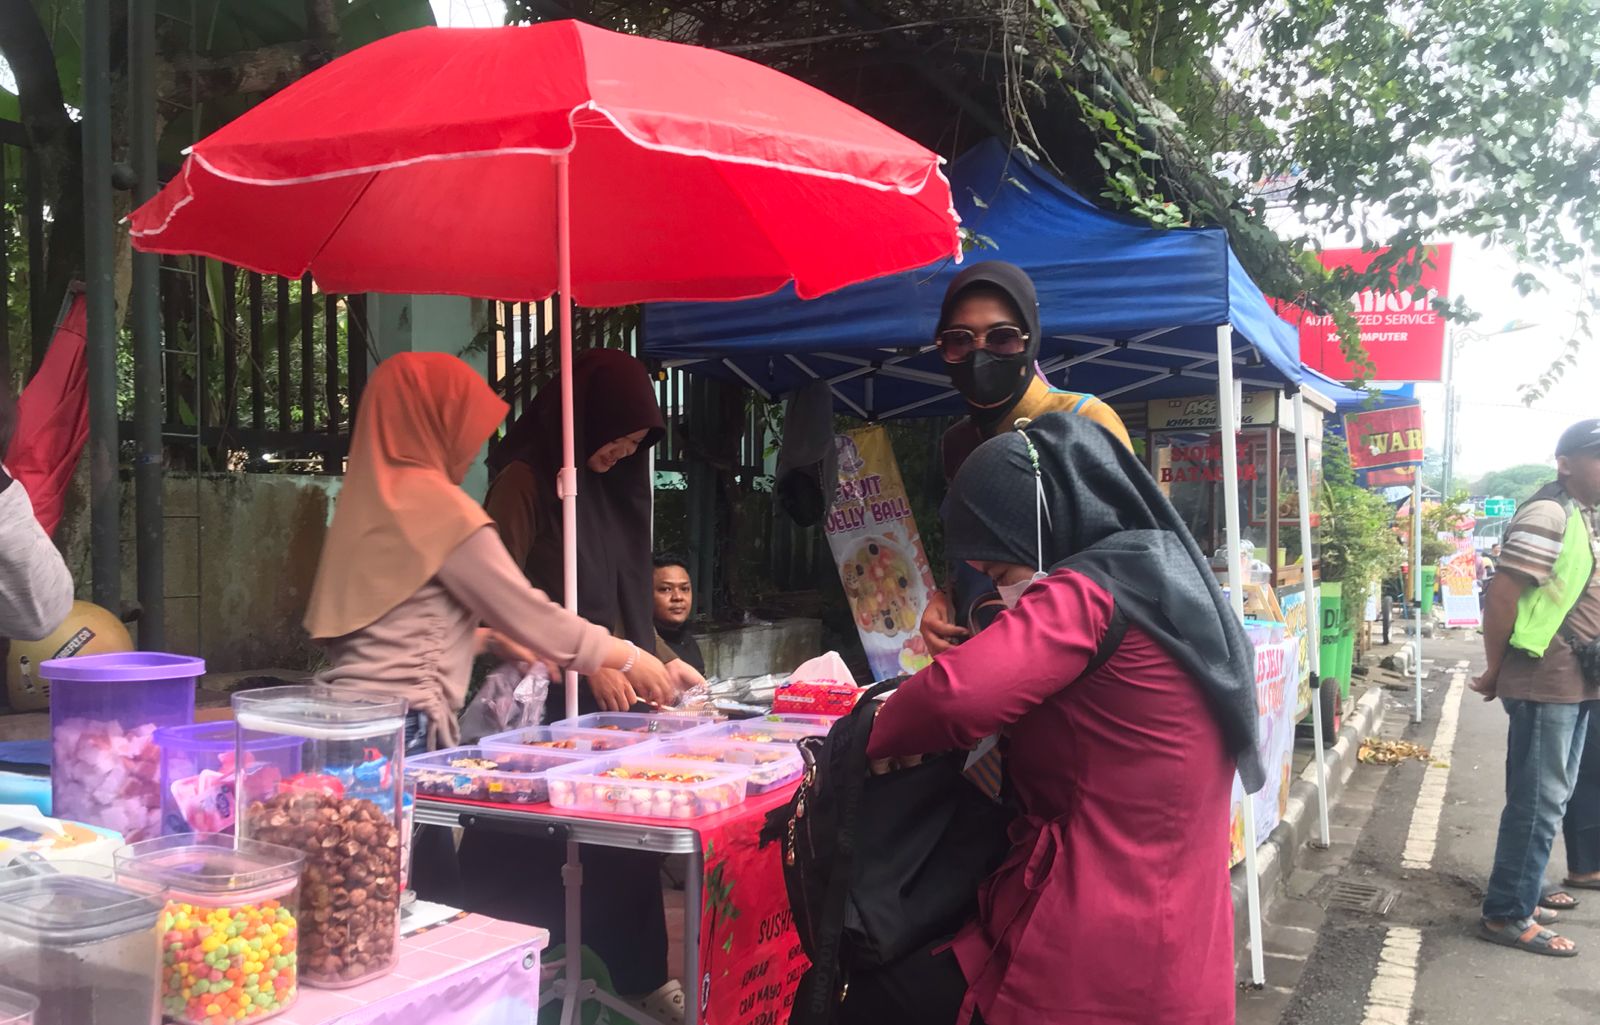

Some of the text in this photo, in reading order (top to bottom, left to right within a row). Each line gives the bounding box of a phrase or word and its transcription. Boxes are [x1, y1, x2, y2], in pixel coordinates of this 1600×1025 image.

[1385, 313, 1436, 326] SERVICE
[825, 496, 911, 533] JELLY BALL
